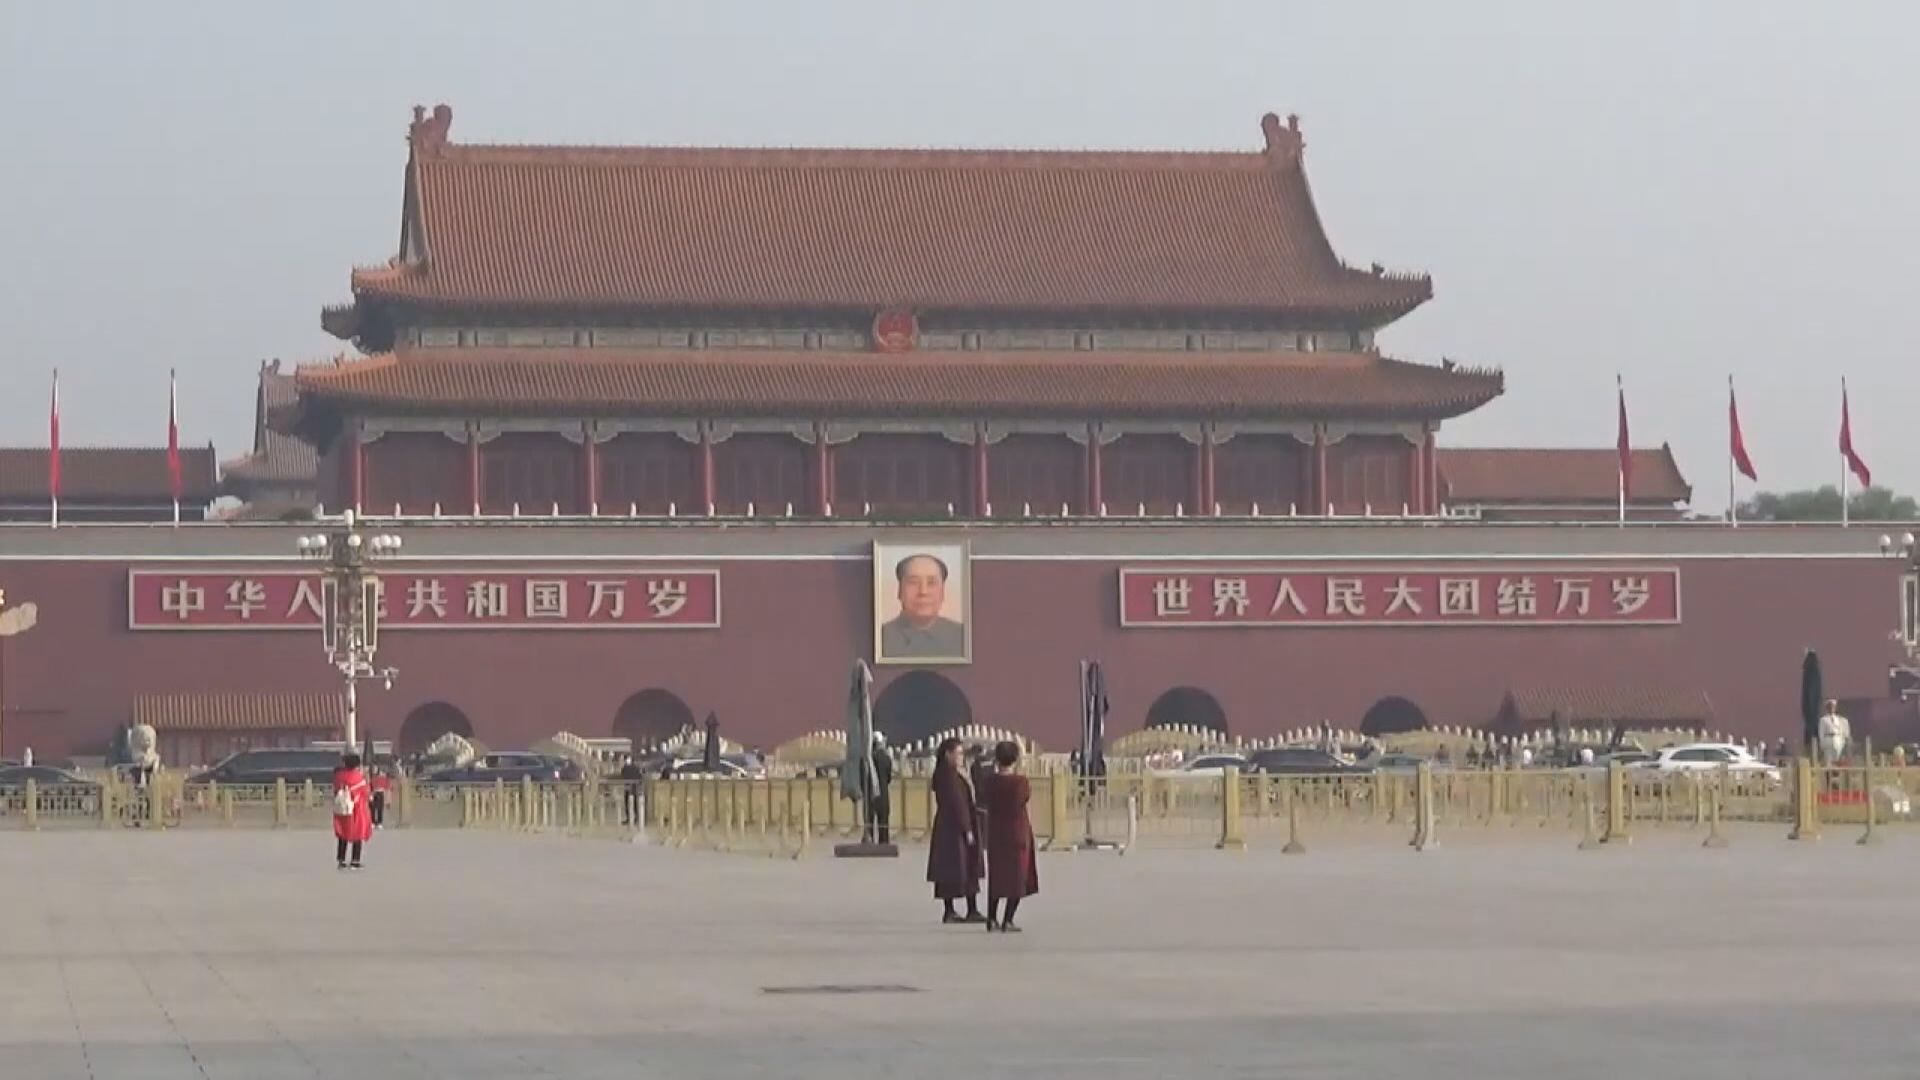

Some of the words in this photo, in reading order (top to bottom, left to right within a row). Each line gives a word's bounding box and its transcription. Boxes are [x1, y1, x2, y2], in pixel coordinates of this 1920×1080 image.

[1152, 577, 1651, 616] 世界人民大团结万岁
